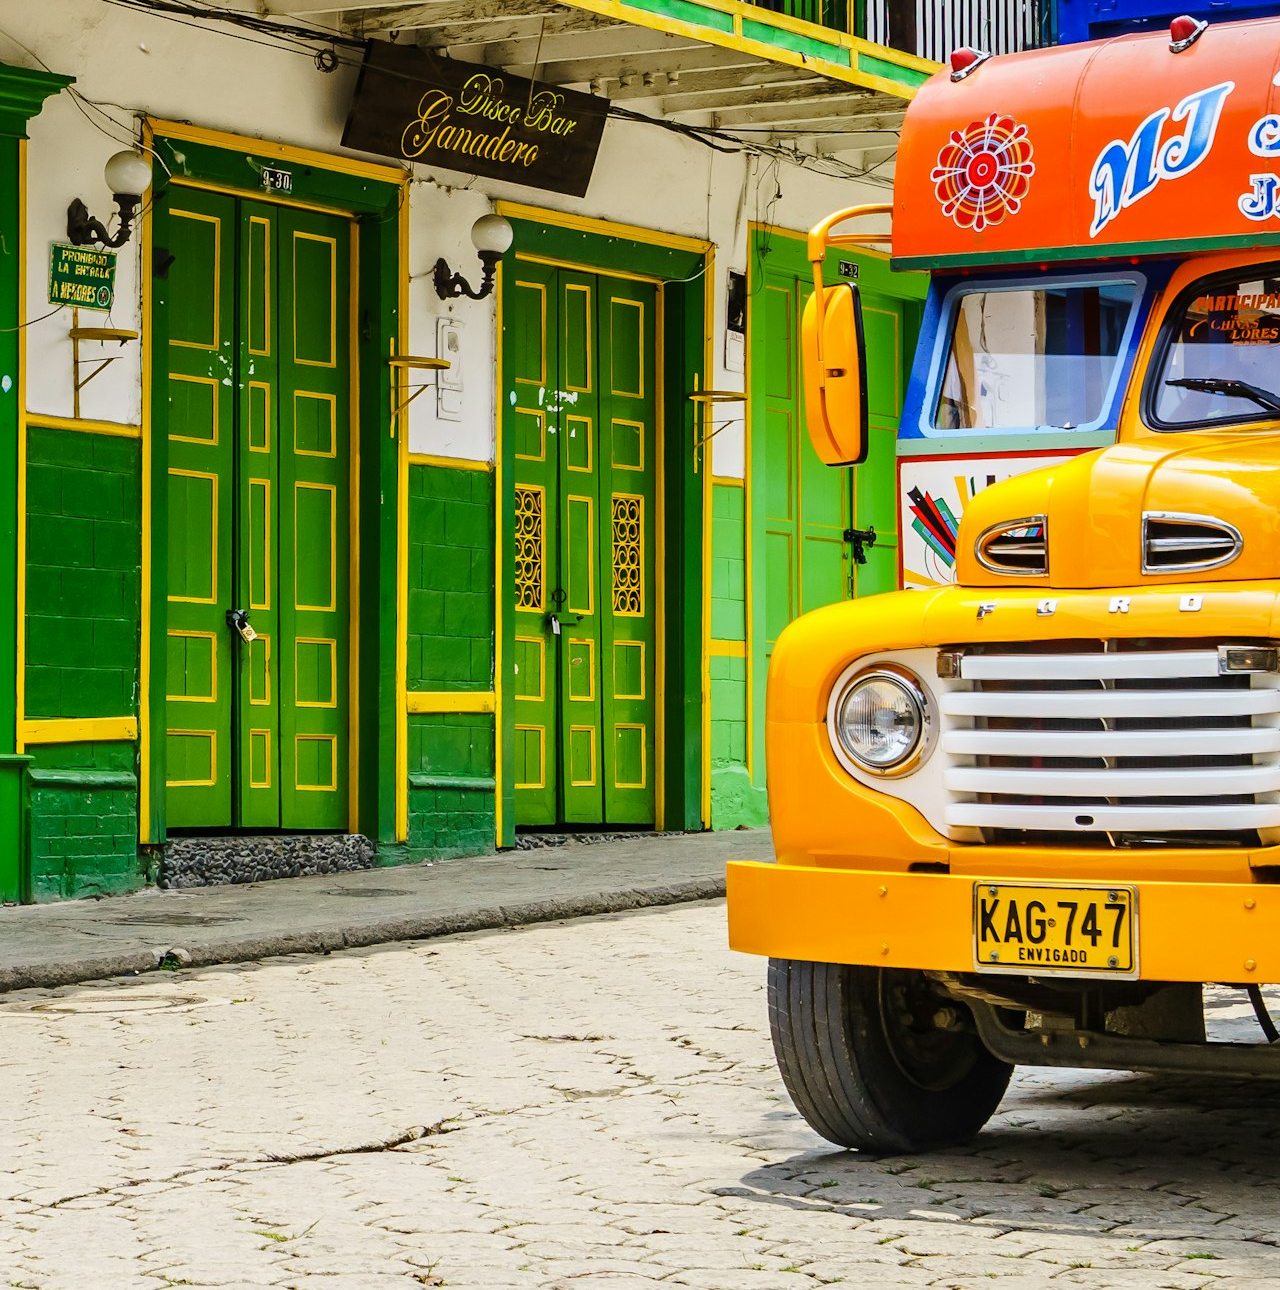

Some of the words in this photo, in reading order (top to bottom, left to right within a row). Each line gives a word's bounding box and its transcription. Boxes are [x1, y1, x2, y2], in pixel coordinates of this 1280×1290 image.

[456, 73, 521, 125] Disco
[523, 91, 577, 136] Bar
[401, 89, 539, 167] Ganadero
[262, 170, 290, 190] 9-30
[62, 250, 107, 266] PROHIBIDO
[58, 262, 69, 274] LA
[75, 264, 110, 279] ENTRADA
[51, 280, 59, 298] A
[976, 594, 1204, 620] FORD
[1018, 947, 1088, 963] ENVIGADO
